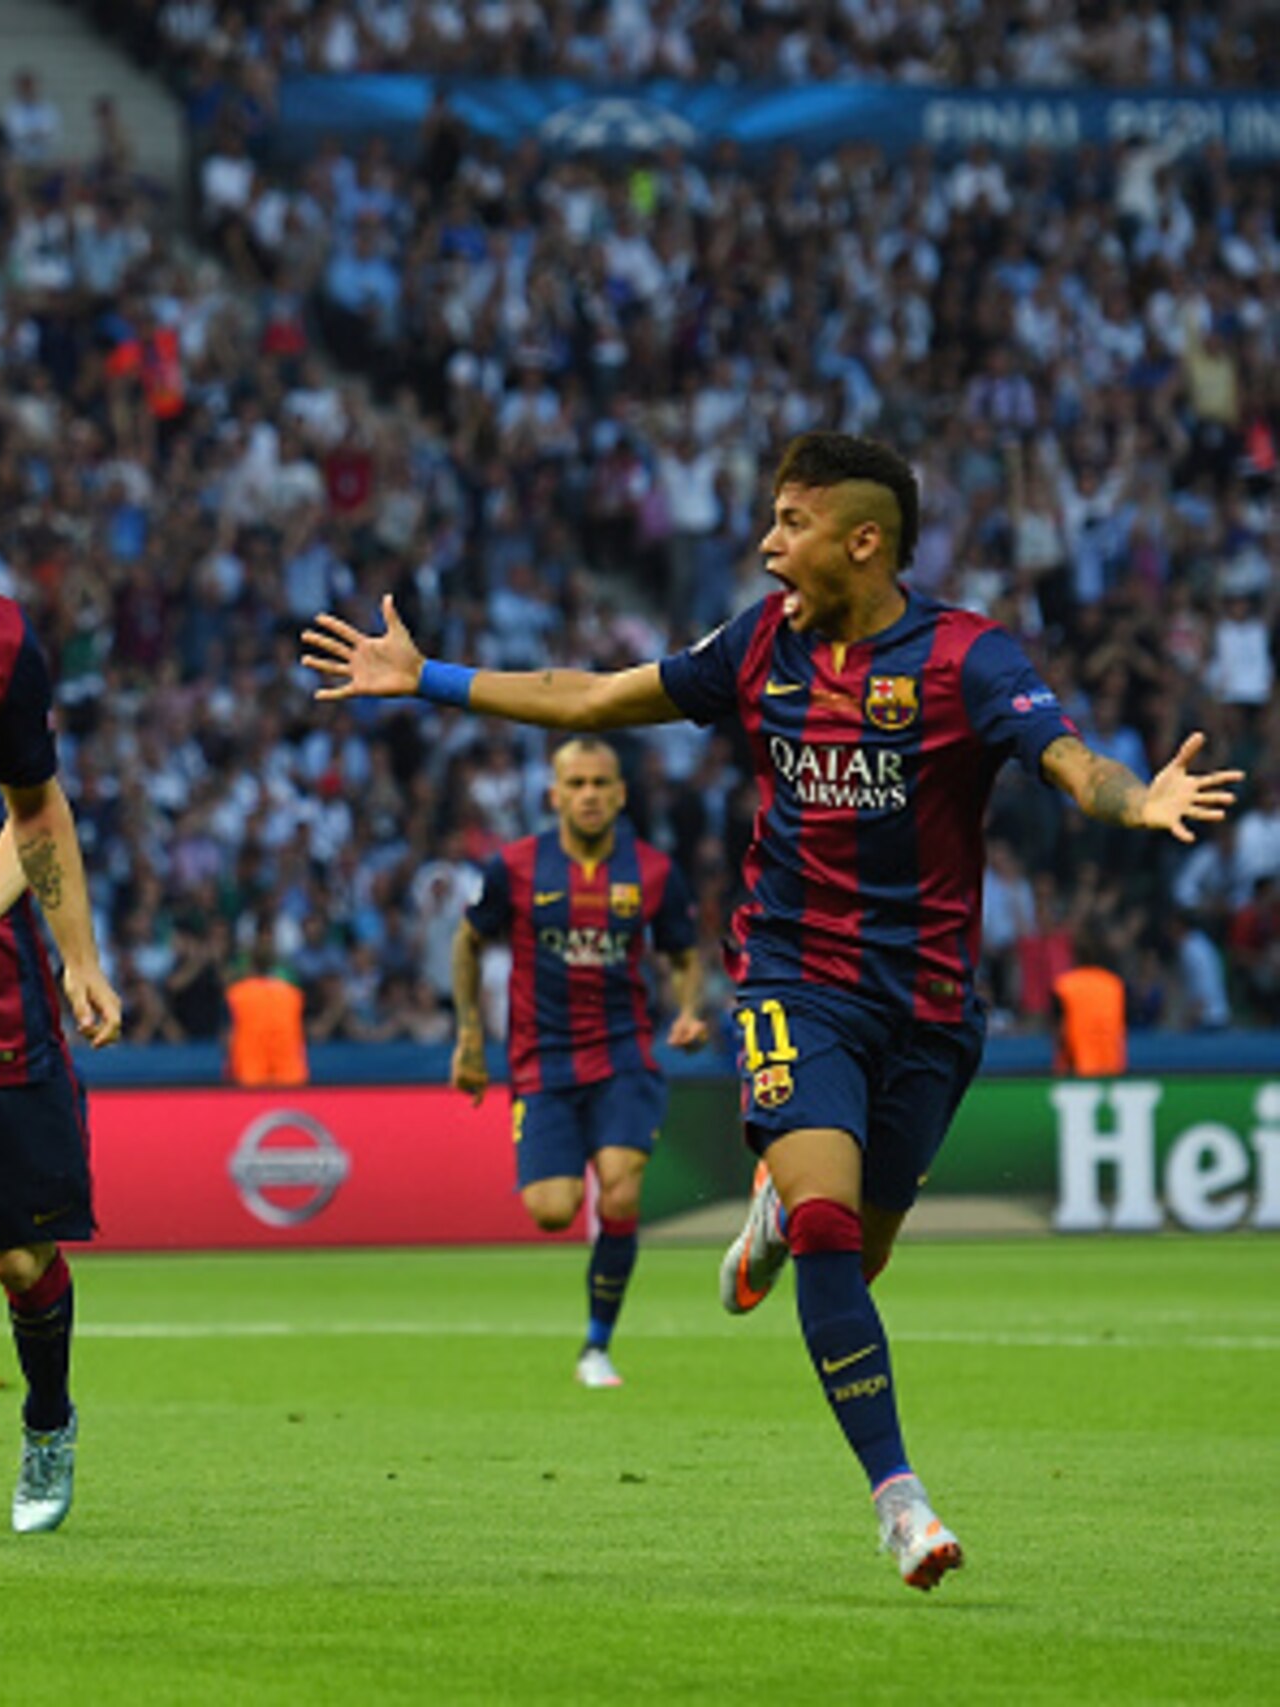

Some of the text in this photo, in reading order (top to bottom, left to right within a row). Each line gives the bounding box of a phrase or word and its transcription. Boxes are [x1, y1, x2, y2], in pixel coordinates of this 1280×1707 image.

[770, 736, 904, 784] QATAR
[793, 779, 908, 810] AIRWAYS
[737, 999, 798, 1072] 11
[1049, 1081, 1280, 1232] Hei
